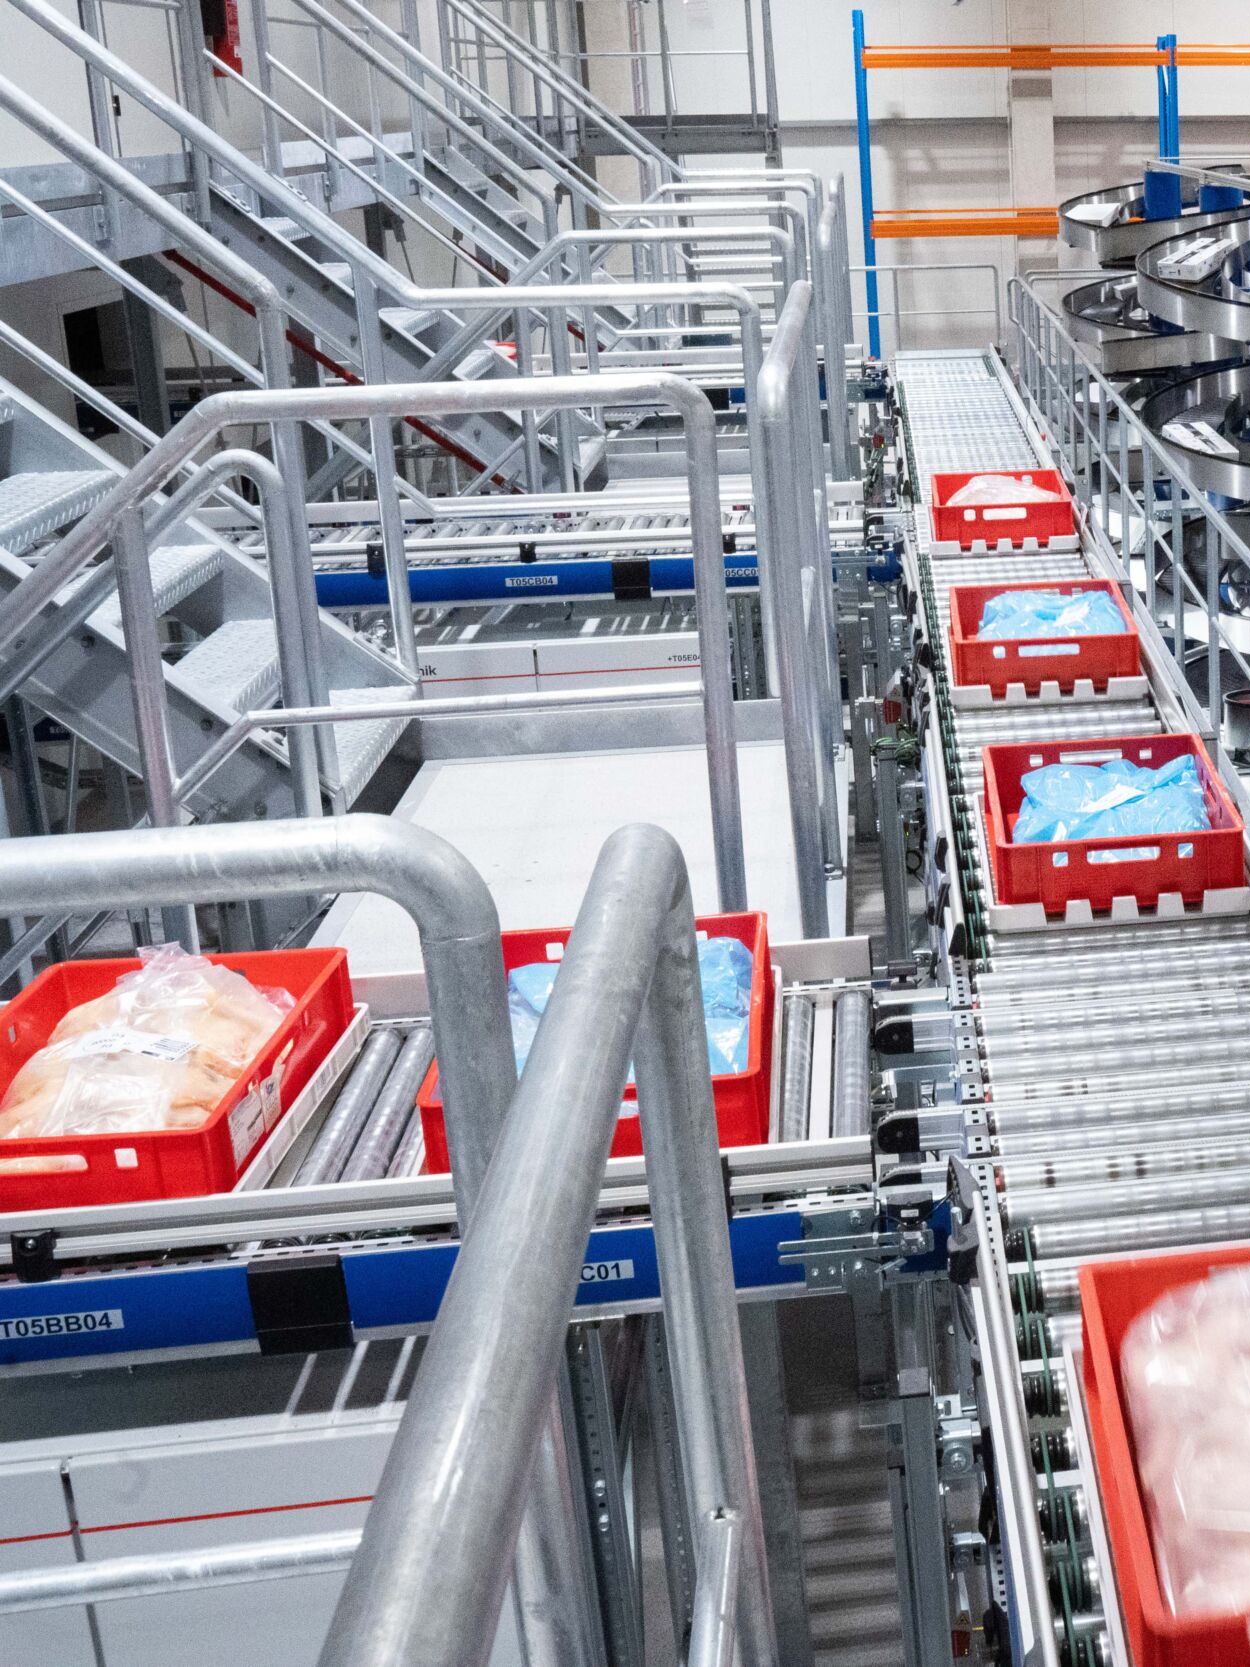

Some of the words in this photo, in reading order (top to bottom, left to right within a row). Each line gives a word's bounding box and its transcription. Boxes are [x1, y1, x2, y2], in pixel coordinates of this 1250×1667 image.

[725, 568, 758, 577] 05CC0
[509, 576, 554, 586] T05CB04
[0, 1311, 113, 1338] T05BB04
